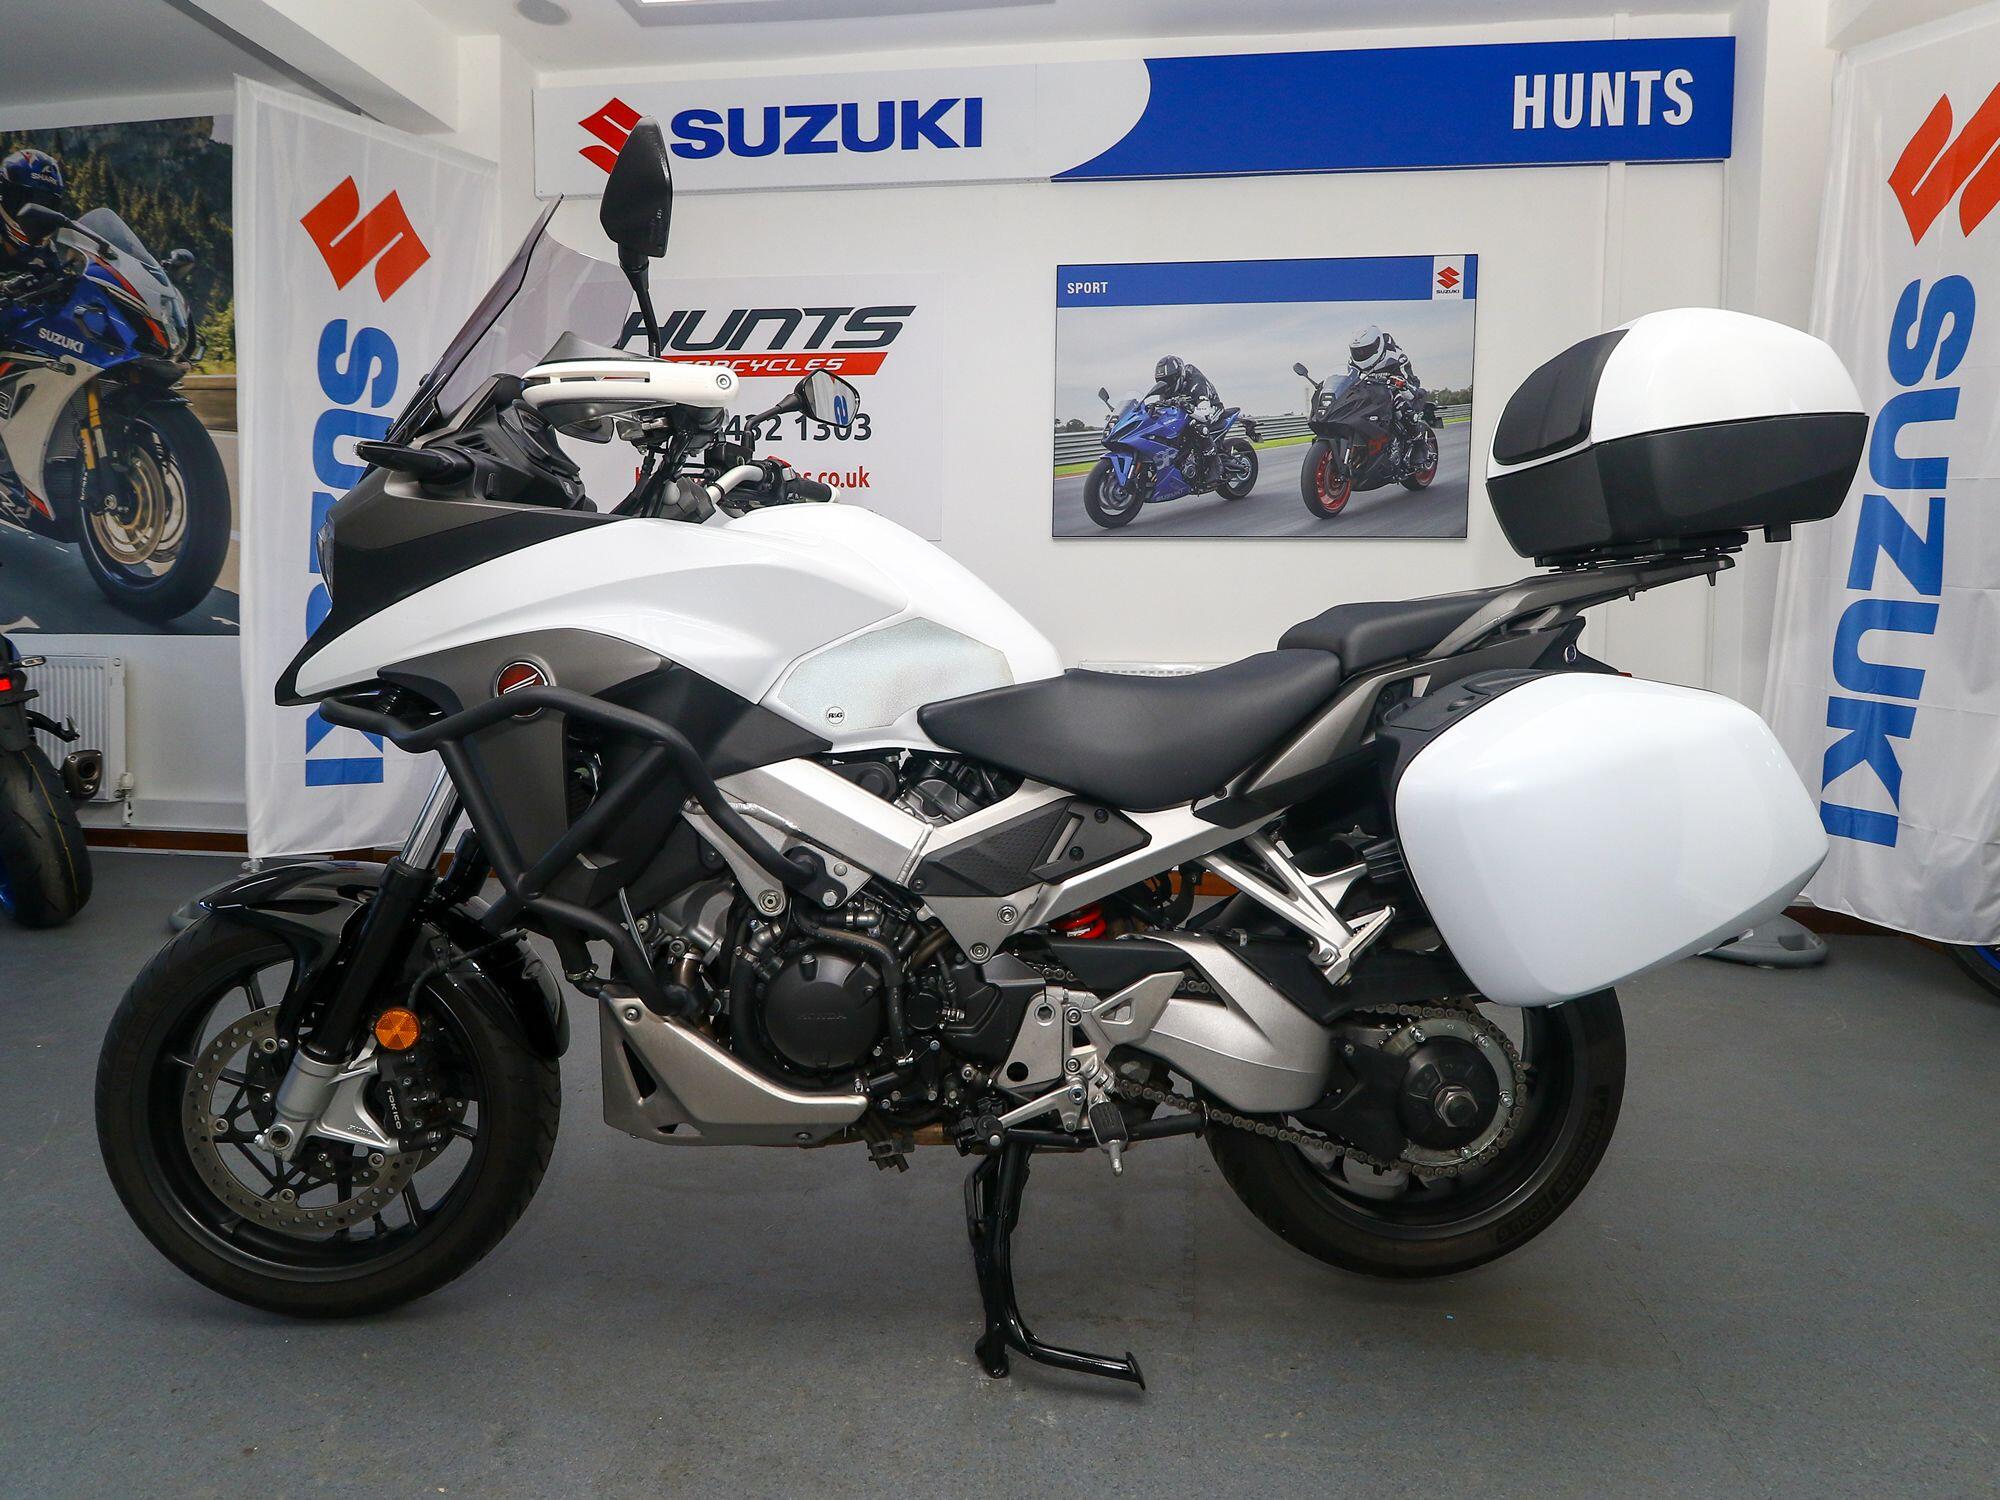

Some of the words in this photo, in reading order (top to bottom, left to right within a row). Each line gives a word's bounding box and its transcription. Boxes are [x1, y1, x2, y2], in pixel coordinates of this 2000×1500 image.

[1511, 69, 1694, 130] HUNTS
[670, 97, 983, 159] SUZUKI
[1067, 281, 1109, 295] SPORT
[38, 327, 85, 354] SUZUKI
[616, 304, 917, 351] HUNTS
[305, 318, 399, 787] SUI
[1821, 274, 1977, 849] SUZUKI
[386, 1087, 402, 1130] TOKICO
